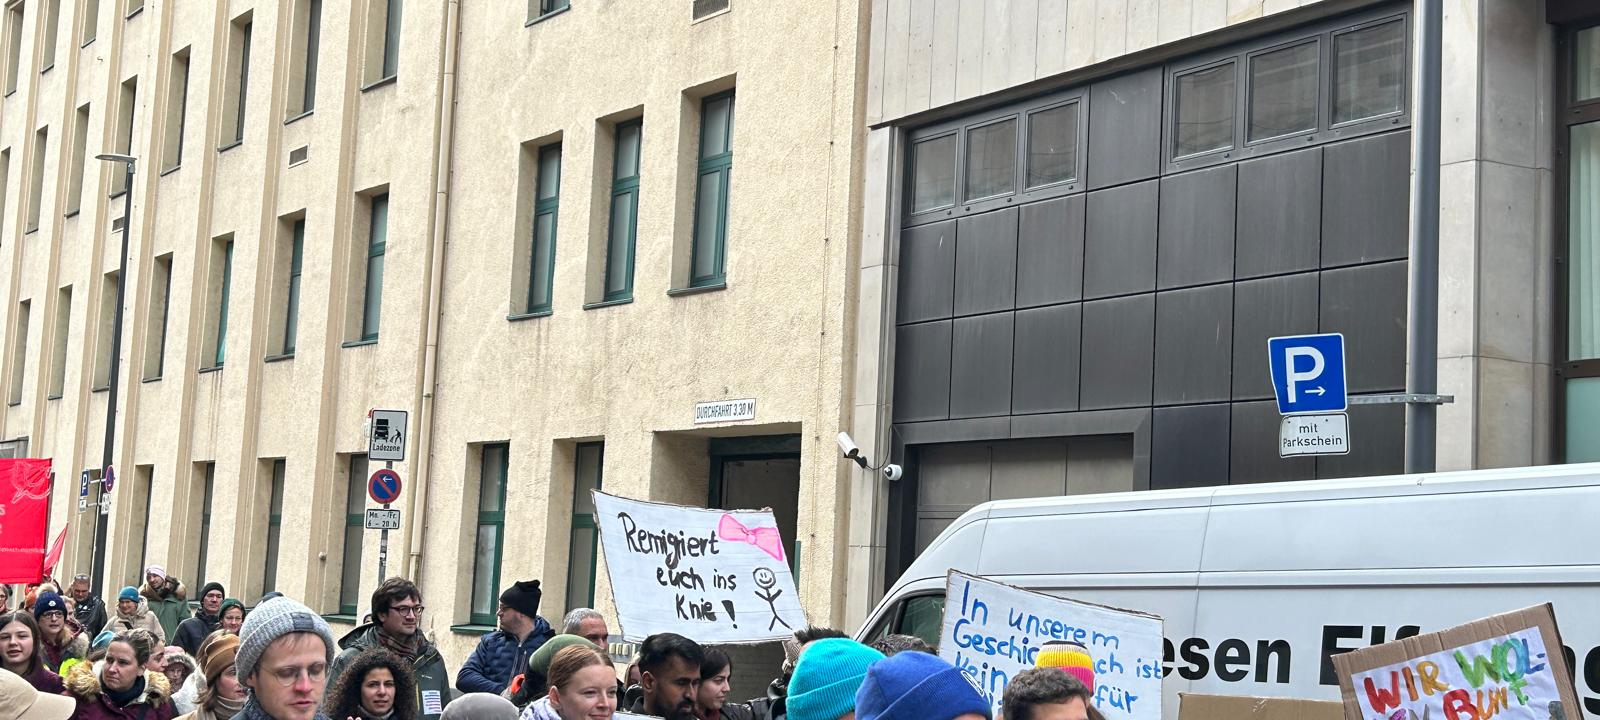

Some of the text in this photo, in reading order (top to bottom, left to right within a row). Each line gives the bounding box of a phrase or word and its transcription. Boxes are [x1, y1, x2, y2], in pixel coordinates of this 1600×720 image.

[1285, 346, 1325, 404] P
[696, 404, 732, 419] DURCHFAHRT
[747, 402, 754, 415] M
[1299, 423, 1318, 433] mit
[372, 443, 401, 452] Ladezone
[1283, 435, 1343, 448] Parkschein
[656, 567, 737, 592] euch ins
[961, 580, 1120, 650] In unserem
[1136, 657, 1162, 680] ist
[1095, 684, 1138, 714] für
[1363, 660, 1450, 714] WIR
